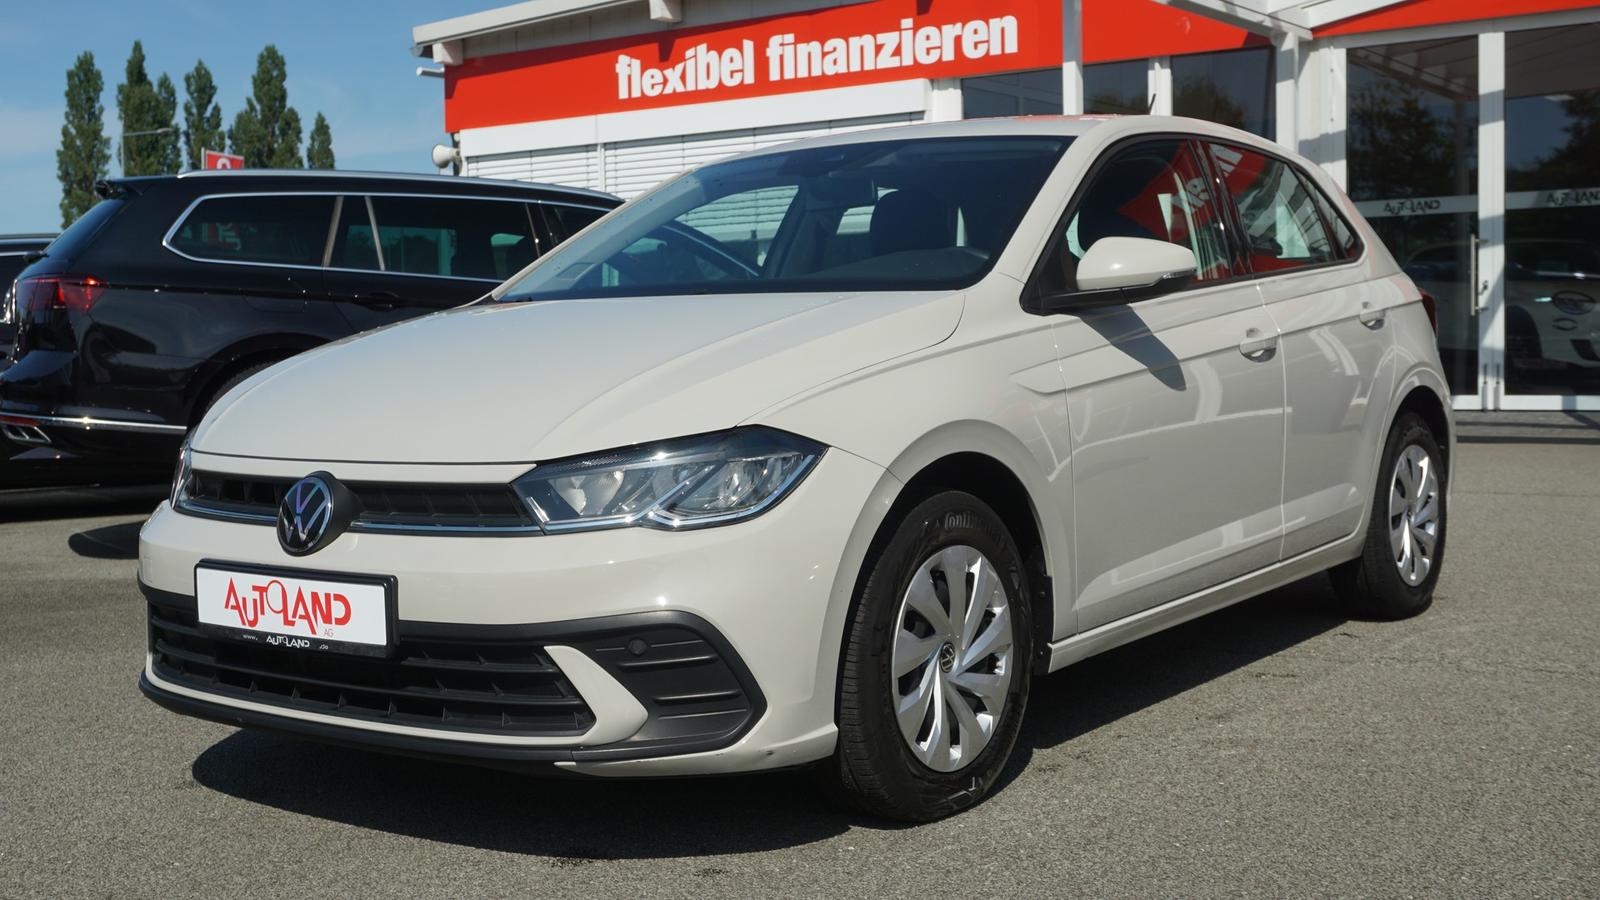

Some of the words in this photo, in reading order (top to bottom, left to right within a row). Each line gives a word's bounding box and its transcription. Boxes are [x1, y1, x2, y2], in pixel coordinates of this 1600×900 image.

[615, 39, 755, 100] flexibel
[766, 14, 1018, 82] finanzieren
[224, 576, 352, 635] AUTOLAND
[266, 635, 310, 649] AUTOLAND
[323, 628, 335, 638] AG
